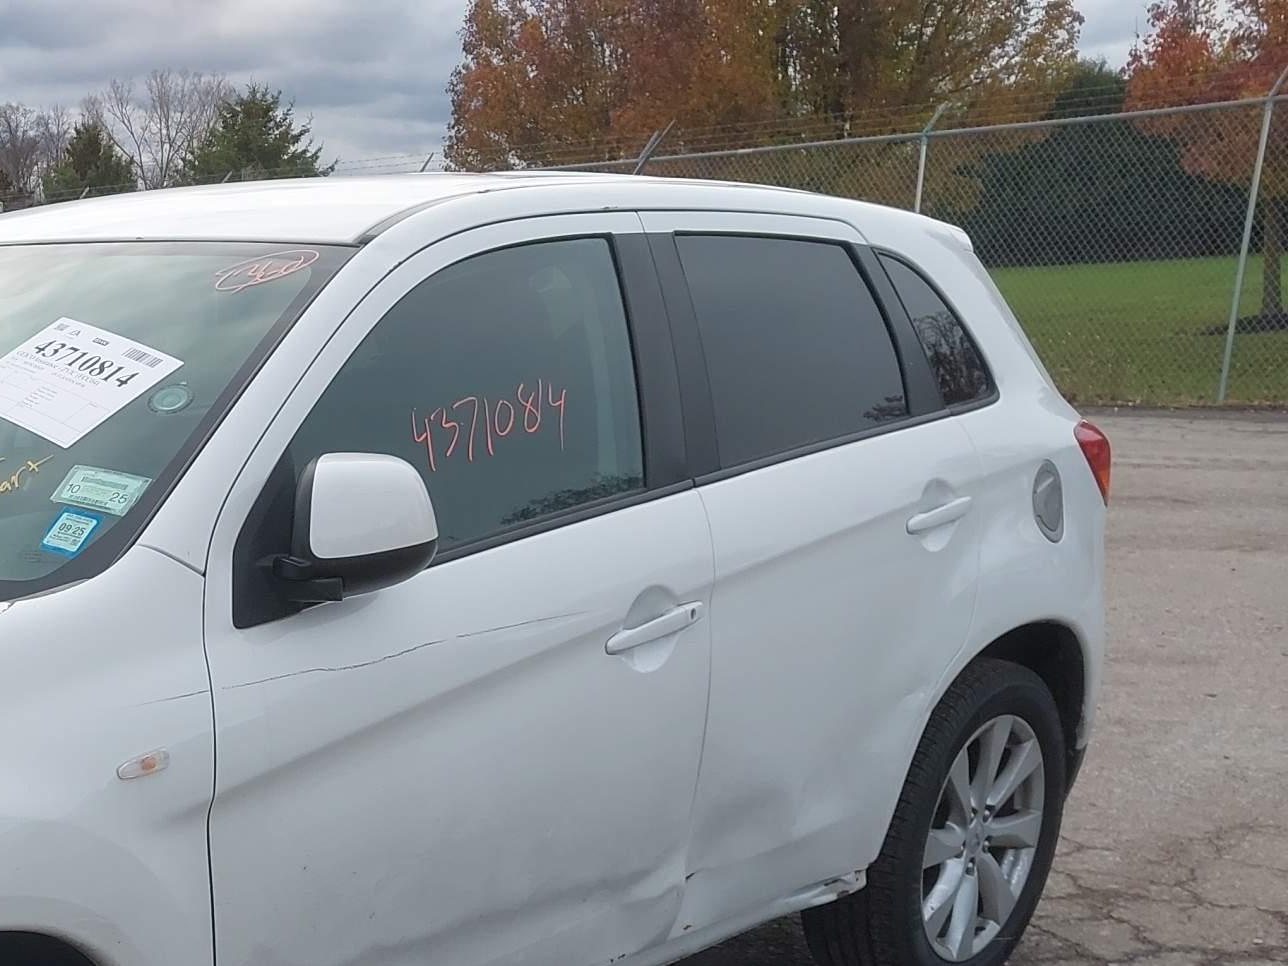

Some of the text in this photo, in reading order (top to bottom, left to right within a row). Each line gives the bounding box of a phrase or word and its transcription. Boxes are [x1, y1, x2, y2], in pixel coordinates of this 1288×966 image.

[34, 340, 139, 388] 43710814
[67, 483, 81, 494] 10
[112, 492, 129, 505] 25
